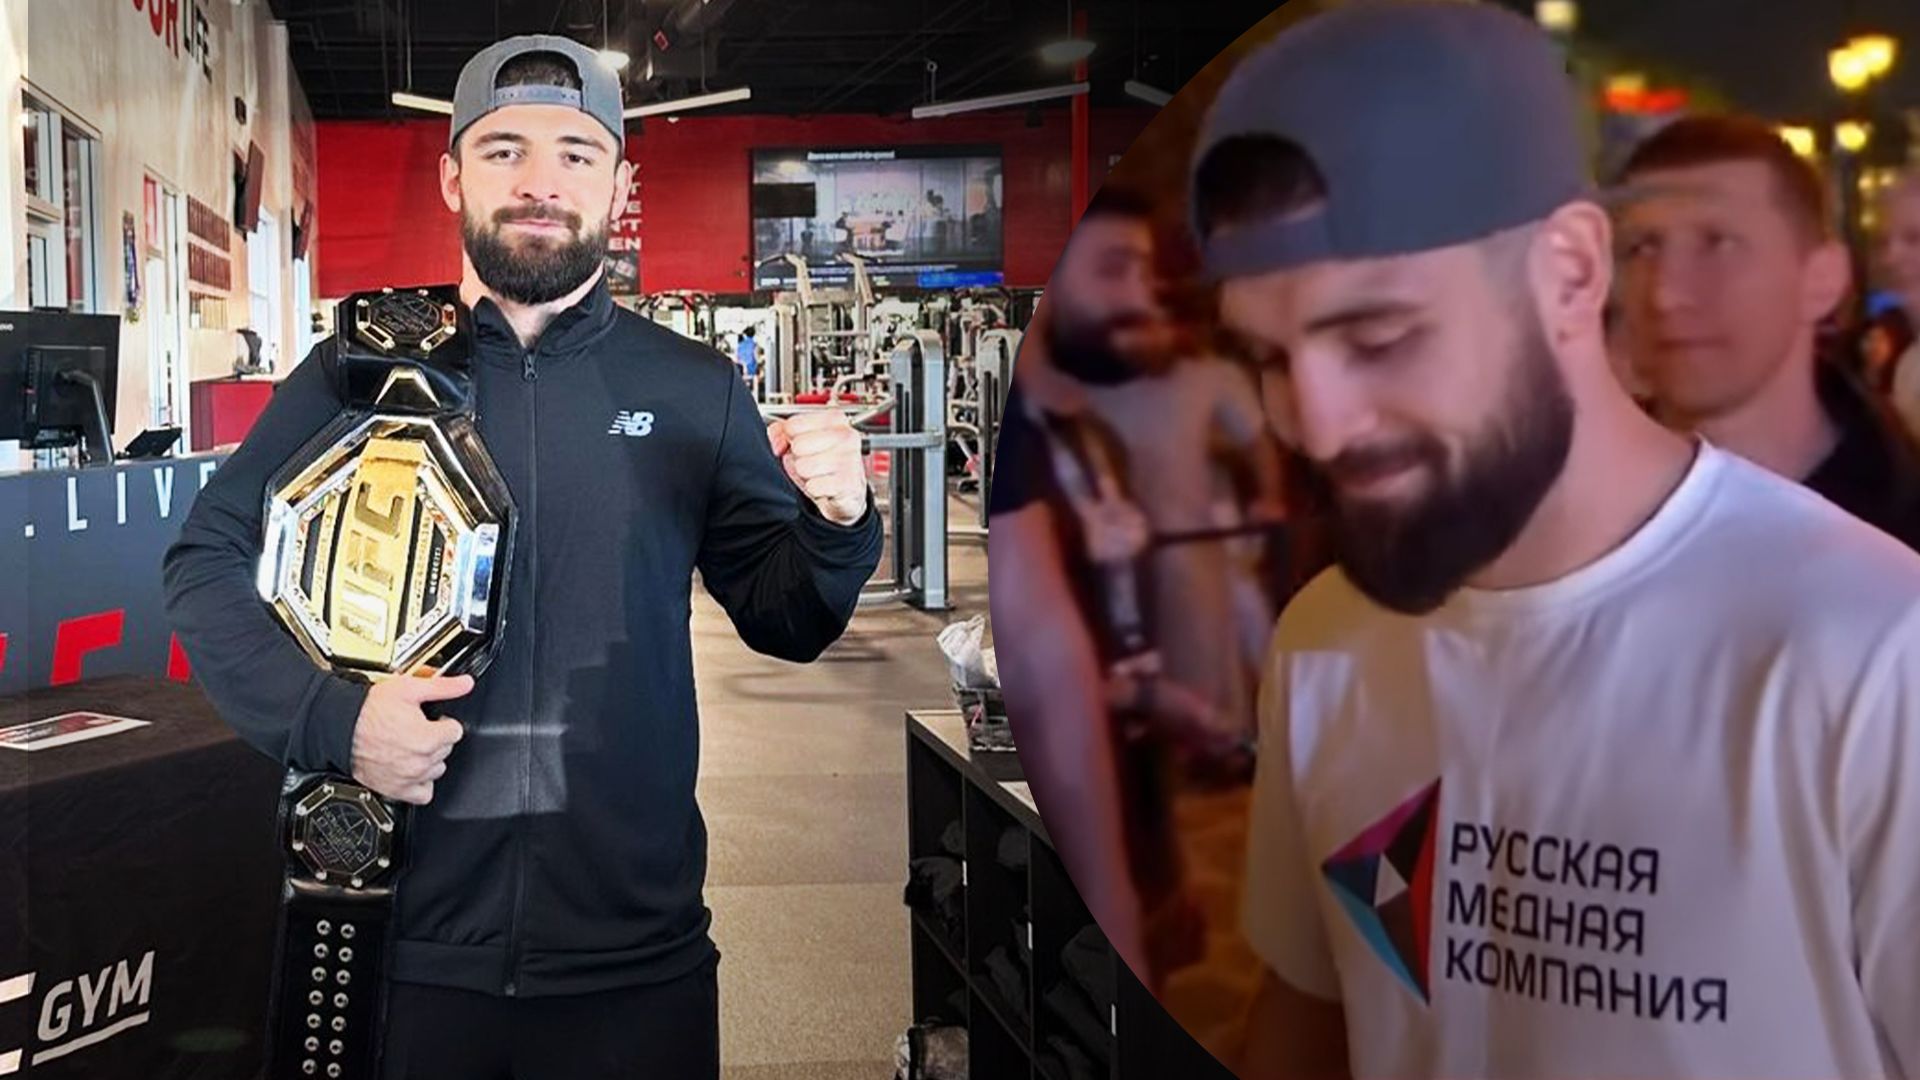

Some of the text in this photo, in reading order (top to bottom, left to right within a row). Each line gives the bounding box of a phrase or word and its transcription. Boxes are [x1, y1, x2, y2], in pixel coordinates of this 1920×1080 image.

[339, 480, 405, 648] UFC
[1450, 822, 1660, 896] РУССКАЯ
[1447, 880, 1645, 957] МЕДНАЯ
[37, 950, 156, 1042] GYM
[1445, 937, 1729, 1025] КОМПАНИЯ
